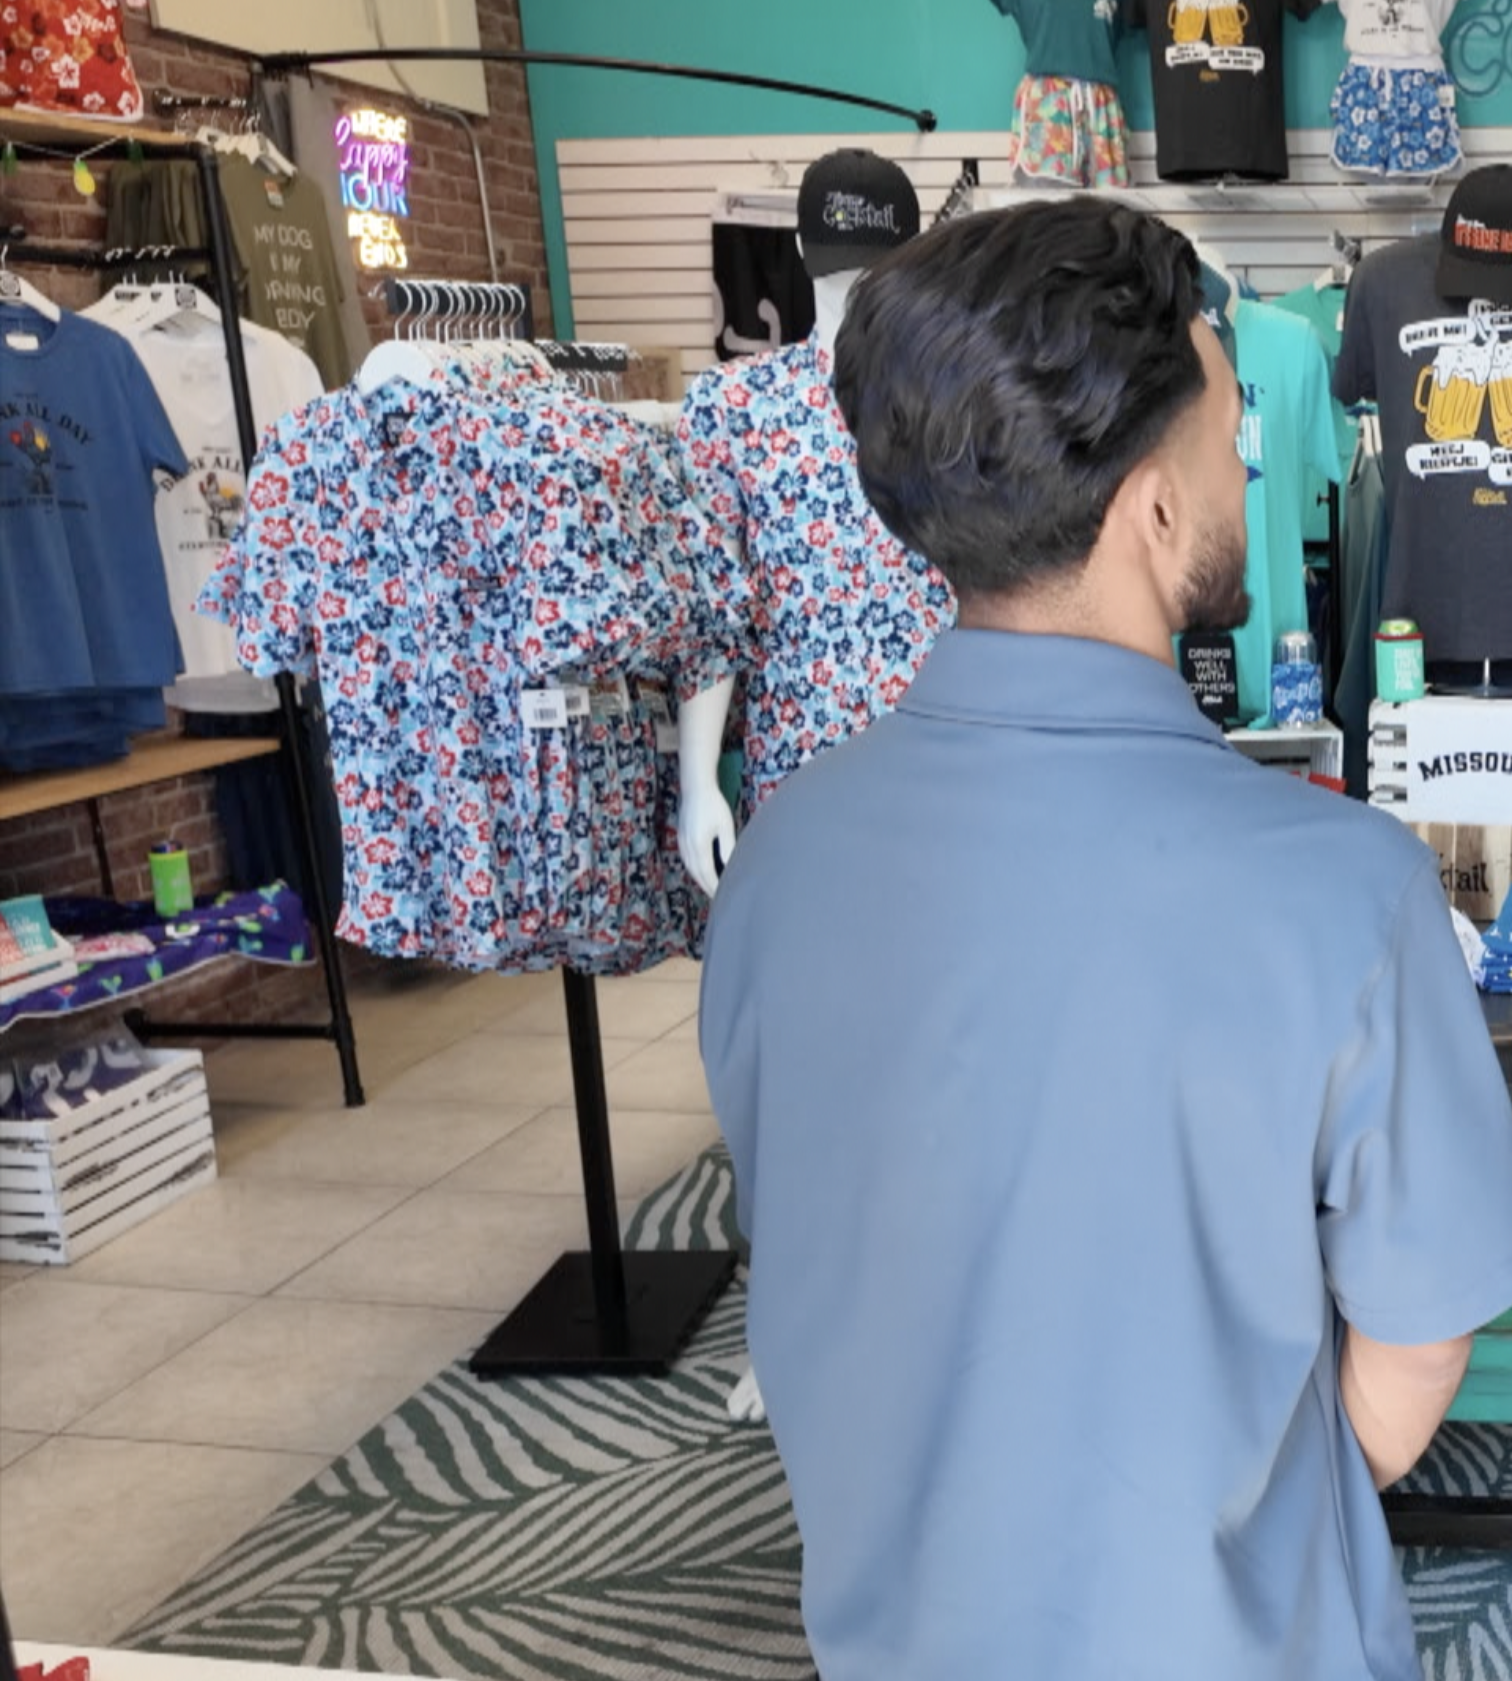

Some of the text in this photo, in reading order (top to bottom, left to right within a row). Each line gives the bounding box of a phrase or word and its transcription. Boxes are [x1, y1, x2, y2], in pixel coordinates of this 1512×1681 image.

[254, 224, 313, 250] MY DOG
[1187, 648, 1231, 659] DRINKS
[1194, 660, 1225, 671] WELL
[1195, 671, 1226, 681] WITH
[1188, 682, 1235, 694] OTHERS
